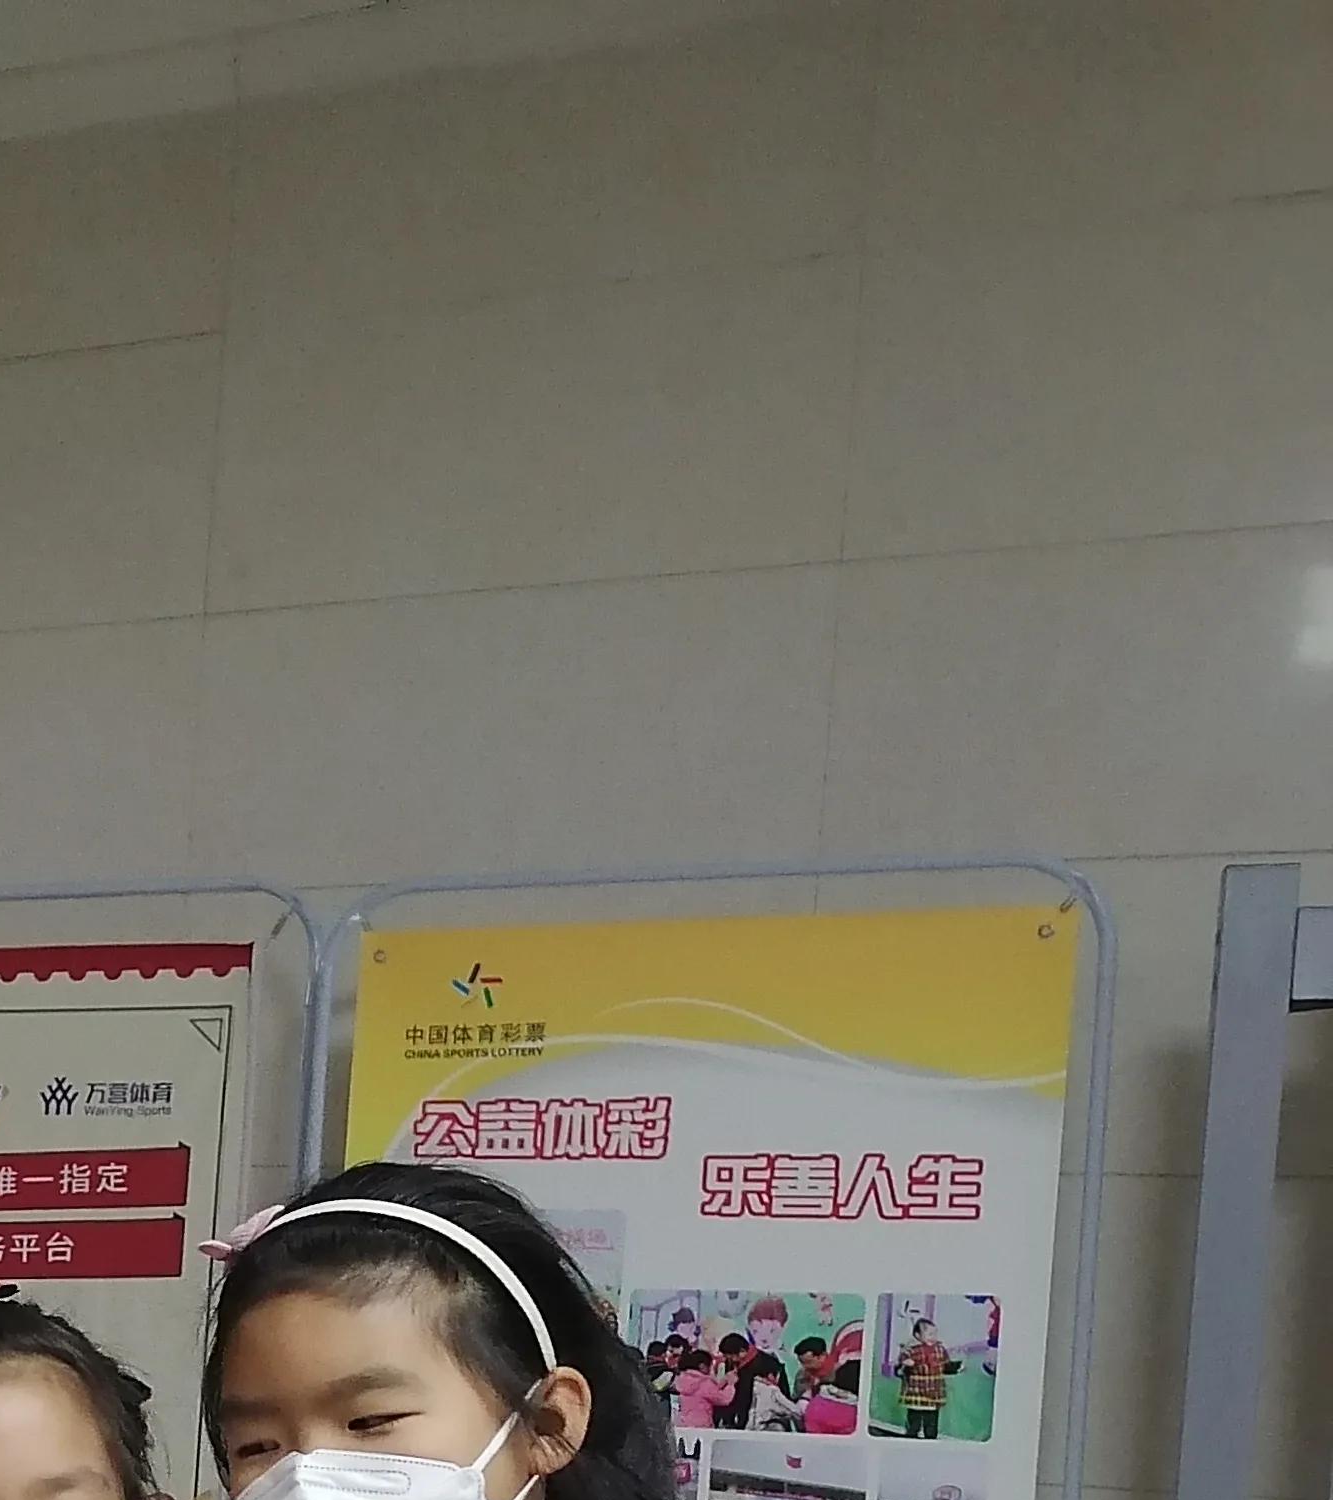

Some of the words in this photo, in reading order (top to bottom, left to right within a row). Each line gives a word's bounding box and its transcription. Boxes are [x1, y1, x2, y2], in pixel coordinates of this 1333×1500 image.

[405, 1021, 547, 1046] 中国体育彩票
[404, 1049, 441, 1060] CHINA
[443, 1048, 490, 1059] SPORTS
[492, 1046, 545, 1057] LOTTERY
[86, 1081, 174, 1104] 万营体育
[136, 1103, 173, 1118] Sports
[413, 1096, 673, 1161] 公益体彩
[700, 1152, 984, 1220] 乐善人生
